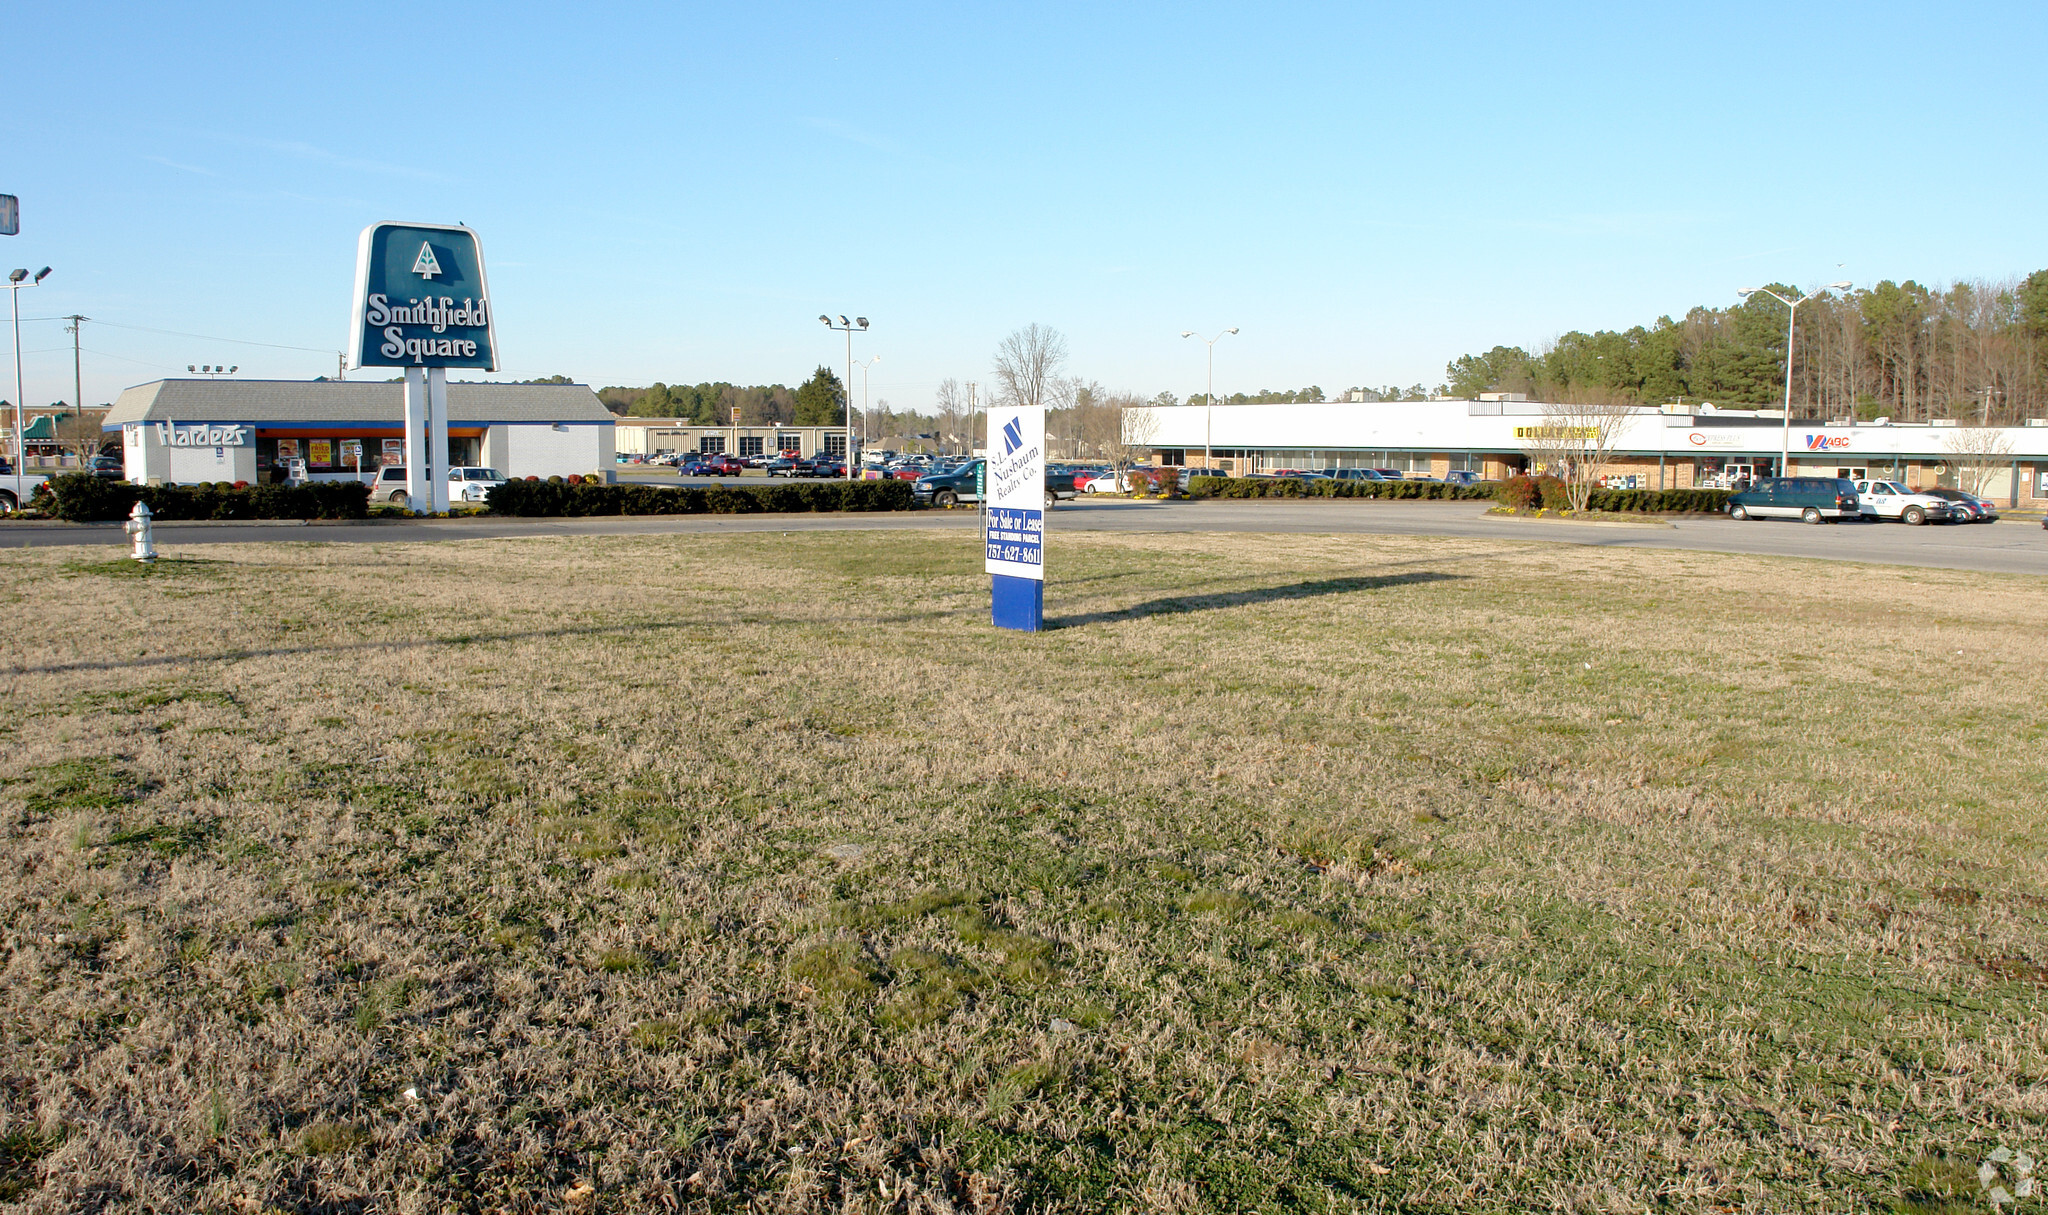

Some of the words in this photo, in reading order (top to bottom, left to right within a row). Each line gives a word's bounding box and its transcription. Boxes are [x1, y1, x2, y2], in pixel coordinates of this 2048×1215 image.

[367, 293, 488, 333] Smithfield
[381, 326, 477, 364] Square
[156, 422, 248, 446] Hardee's
[1824, 437, 1850, 447] ABC
[991, 451, 1007, 470] S.L.
[994, 446, 1039, 486] Nusbaum
[996, 476, 1021, 501] Realty
[1022, 466, 1037, 481] Co.
[988, 509, 999, 528] For
[999, 509, 1013, 530] Sale
[1014, 517, 1022, 530] or
[1022, 511, 1042, 532] Lease
[989, 530, 1000, 540] FREE
[1000, 531, 1022, 542] STANDING
[1022, 533, 1040, 544] PARCEL
[988, 543, 1040, 564] 757-627-8611
